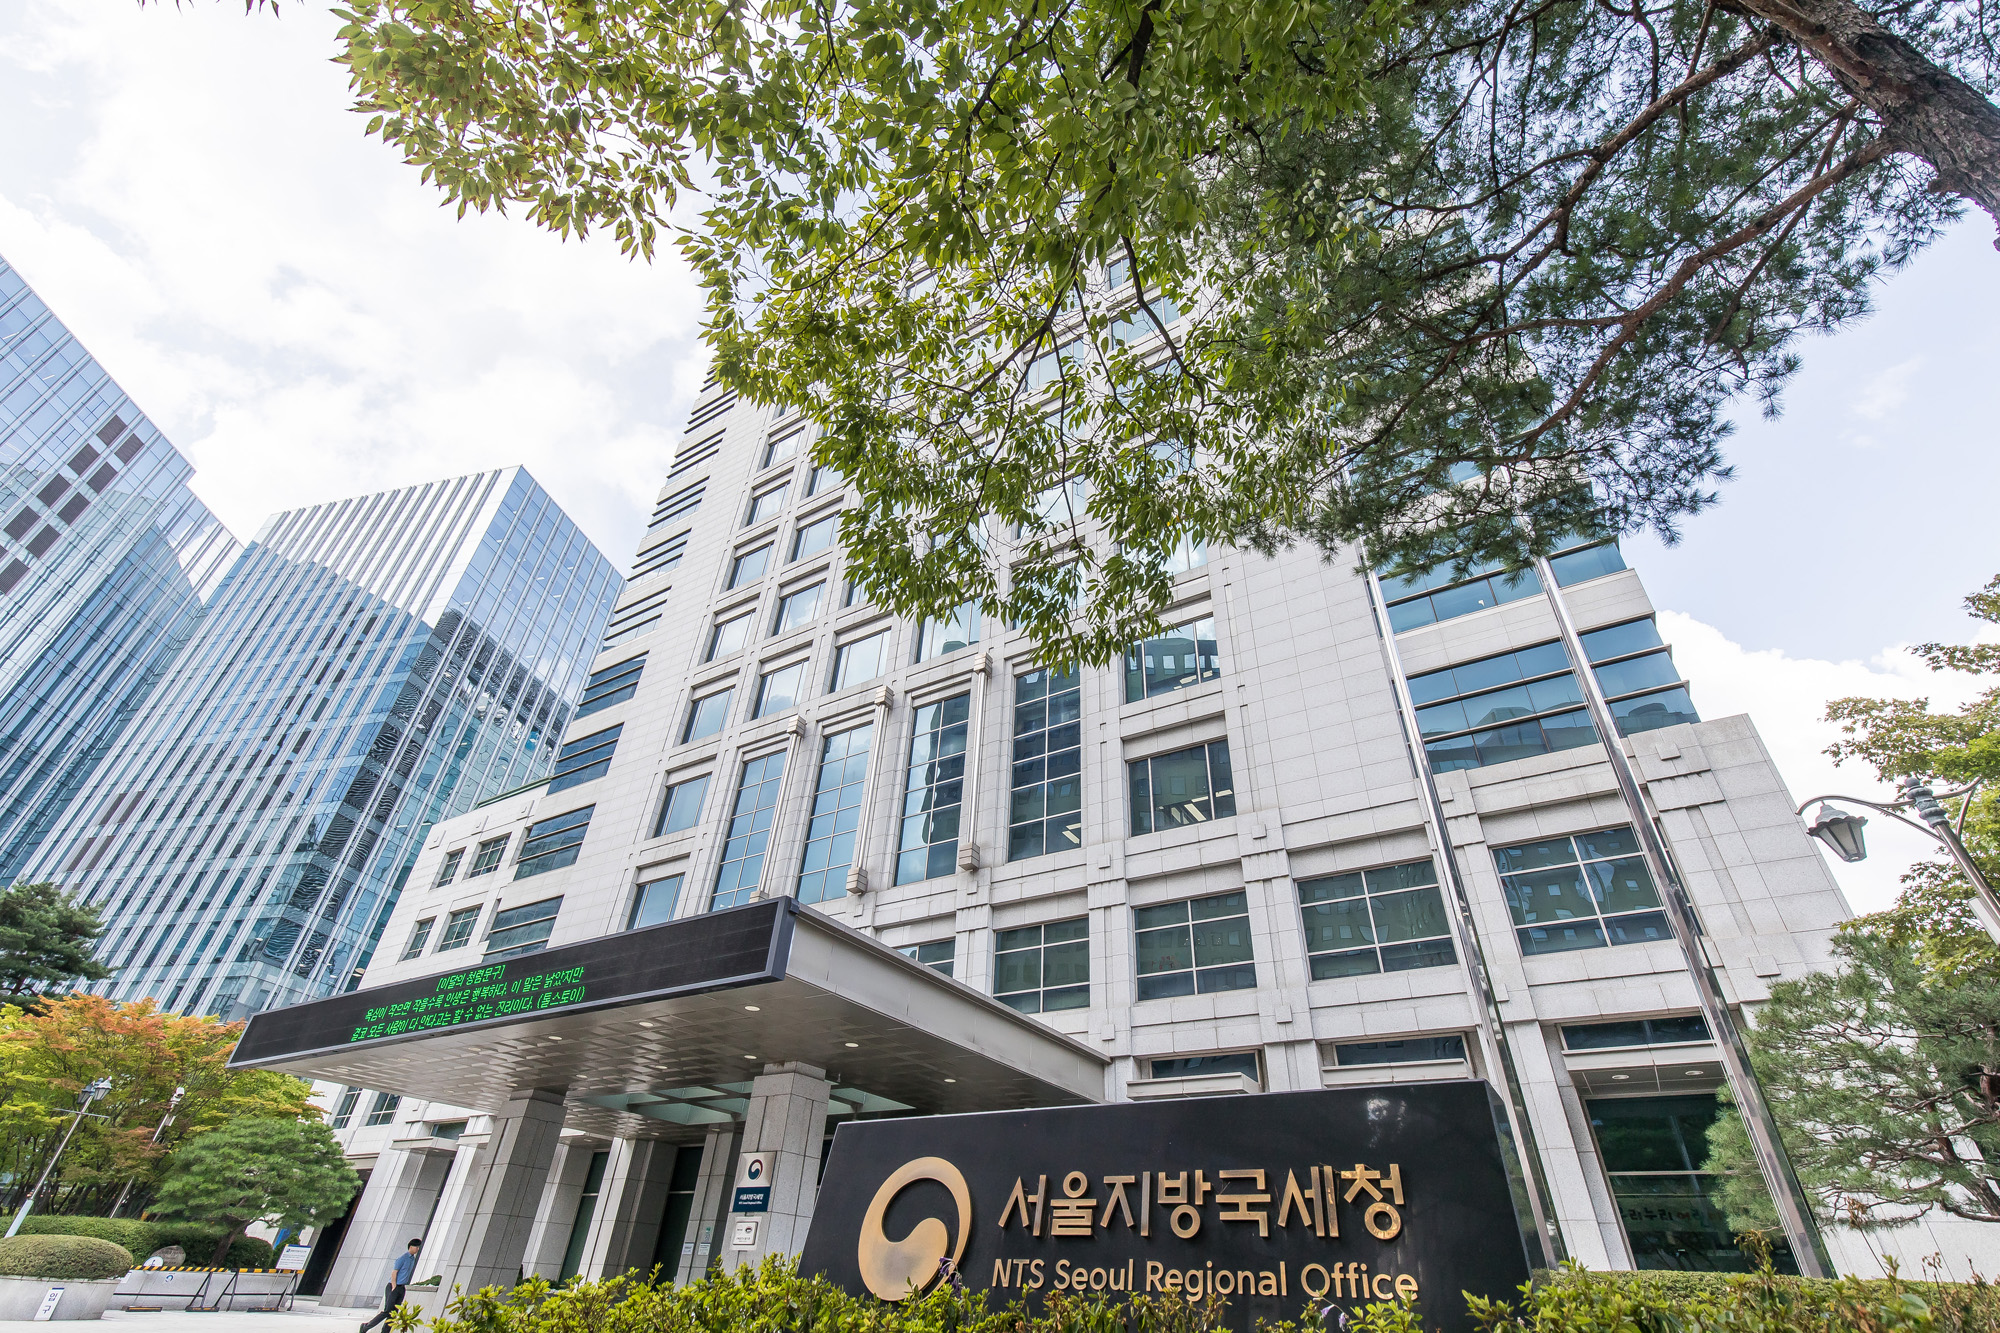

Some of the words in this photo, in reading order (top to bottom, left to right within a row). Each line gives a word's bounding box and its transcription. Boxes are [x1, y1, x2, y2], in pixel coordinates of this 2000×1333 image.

[365, 1005, 388, 1022] 욕심이
[388, 1000, 412, 1017] 작으면
[412, 994, 444, 1013] 작을수록
[444, 989, 470, 1008] 인생은
[472, 982, 507, 1003] 행복하다.
[511, 979, 522, 994] 이
[522, 975, 543, 993] 말은
[543, 966, 585, 989] 낡았지만
[436, 973, 466, 992] [이달의
[466, 964, 506, 986] 청렴문구]
[350, 1027, 368, 1042] 결코
[367, 1022, 385, 1038] 모든
[384, 1018, 409, 1036] 사람이
[408, 1016, 419, 1031] 다
[418, 1011, 452, 1030] 안다고는
[452, 1008, 465, 1024] 할
[464, 1007, 474, 1022] 수
[474, 1003, 493, 1020] 없는
[494, 995, 533, 1017] 진리이다.
[537, 986, 586, 1009] (톨스토이)
[998, 1163, 1405, 1241] 서울지방국세청
[992, 1258, 1045, 1289] NTS
[1054, 1259, 1134, 1292] Seoul
[1146, 1260, 1288, 1302] Regional
[1300, 1262, 1419, 1301] Office
